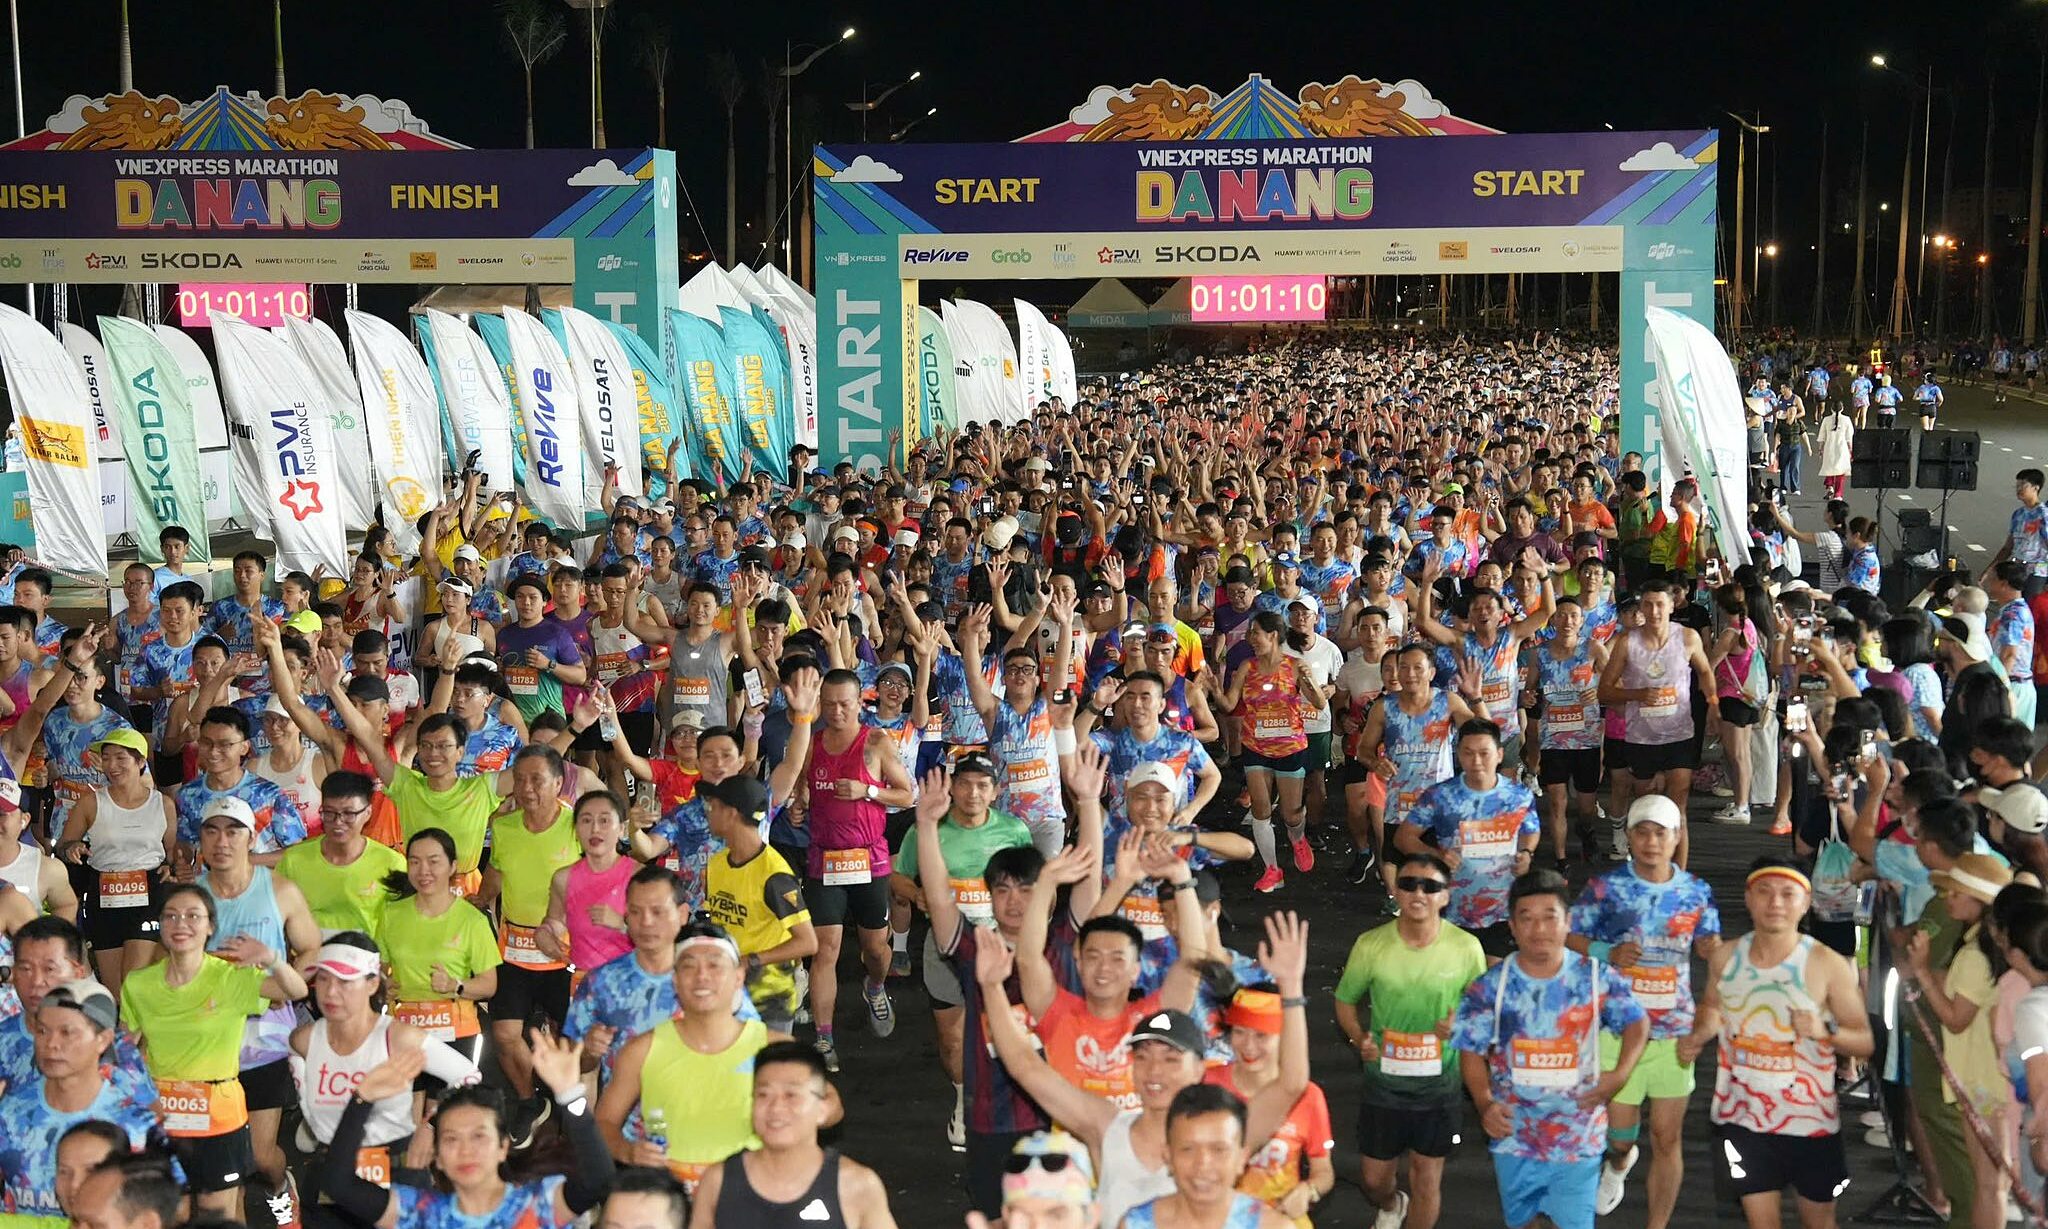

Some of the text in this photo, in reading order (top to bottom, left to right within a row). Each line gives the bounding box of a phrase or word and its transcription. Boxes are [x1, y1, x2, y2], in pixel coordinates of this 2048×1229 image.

[115, 158, 338, 175] VNEXPRESS MARATHON
[1137, 146, 1372, 167] VNEXPRESS MARATHON
[935, 177, 1041, 204] START
[1135, 168, 1374, 223] DA NANG
[1472, 169, 1584, 197] START
[0, 184, 66, 209] ISH
[115, 178, 342, 230] DA NANG
[390, 184, 499, 209] FINISH
[0, 253, 22, 269] ab
[101, 255, 126, 265] PVI
[597, 254, 622, 271] FPT
[824, 252, 887, 266] VNEXPRESS
[904, 248, 969, 265] ReVive
[991, 247, 1032, 264] Grab
[1114, 249, 1139, 259] PVI
[179, 289, 308, 319] 01:01:10
[1191, 283, 1326, 312] 01:01:10
[1090, 315, 1126, 324] MEDAL
[686, 361, 701, 408] MARATHON
[735, 354, 745, 400] MARATHON
[799, 343, 814, 416] VELOSAR
[836, 289, 882, 478] START
[83, 355, 103, 428] VELOSAR
[743, 355, 770, 449] DA NANG
[765, 388, 776, 417] 2025
[594, 357, 616, 467] VELOSAR
[632, 368, 668, 470] DA NANG
[654, 402, 671, 434] 2025
[695, 359, 725, 460] DA NANG
[719, 395, 731, 425] 2025
[293, 401, 317, 475] INSURANCE
[533, 367, 564, 488] ReVive
[270, 409, 305, 477] PVI
[55, 452, 79, 463] BALM
[511, 675, 535, 685] 81782
[681, 686, 708, 694] 80689
[1263, 718, 1289, 727] 82882
[1556, 713, 1582, 721] 82325
[1017, 767, 1047, 781] 82840
[1473, 830, 1511, 842] 82044
[835, 859, 867, 871] 82801
[102, 882, 146, 893] F 80496
[410, 1012, 451, 1026] 82445
